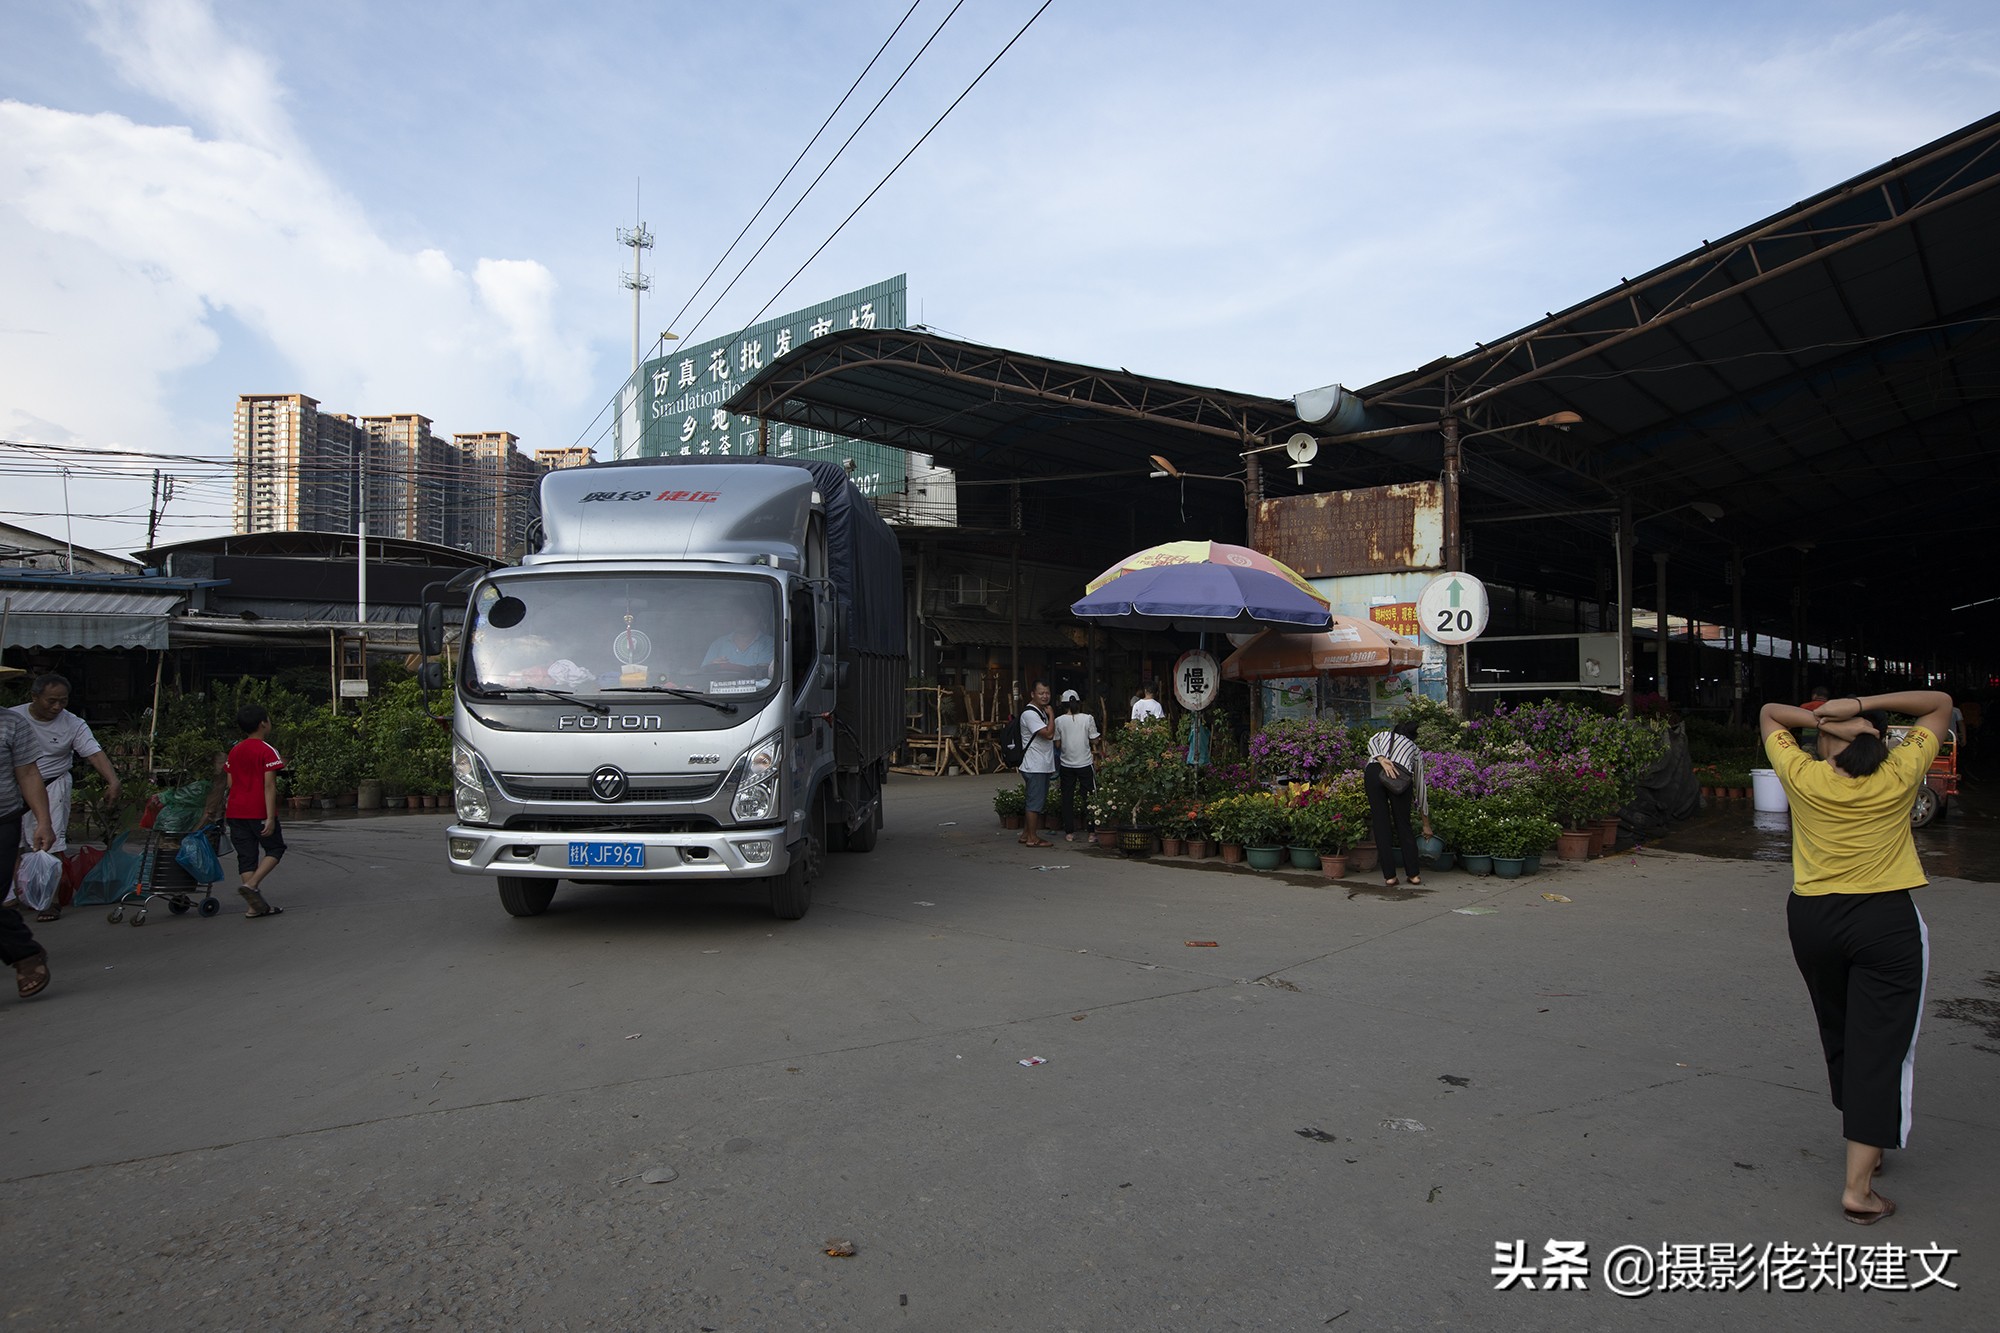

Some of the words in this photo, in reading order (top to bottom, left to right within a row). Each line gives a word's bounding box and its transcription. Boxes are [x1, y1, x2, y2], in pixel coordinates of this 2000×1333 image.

[1437, 609, 1473, 632] 20
[1183, 668, 1205, 694] 慢
[558, 714, 662, 730] FOTON
[570, 845, 643, 864] 桂K·JF967
